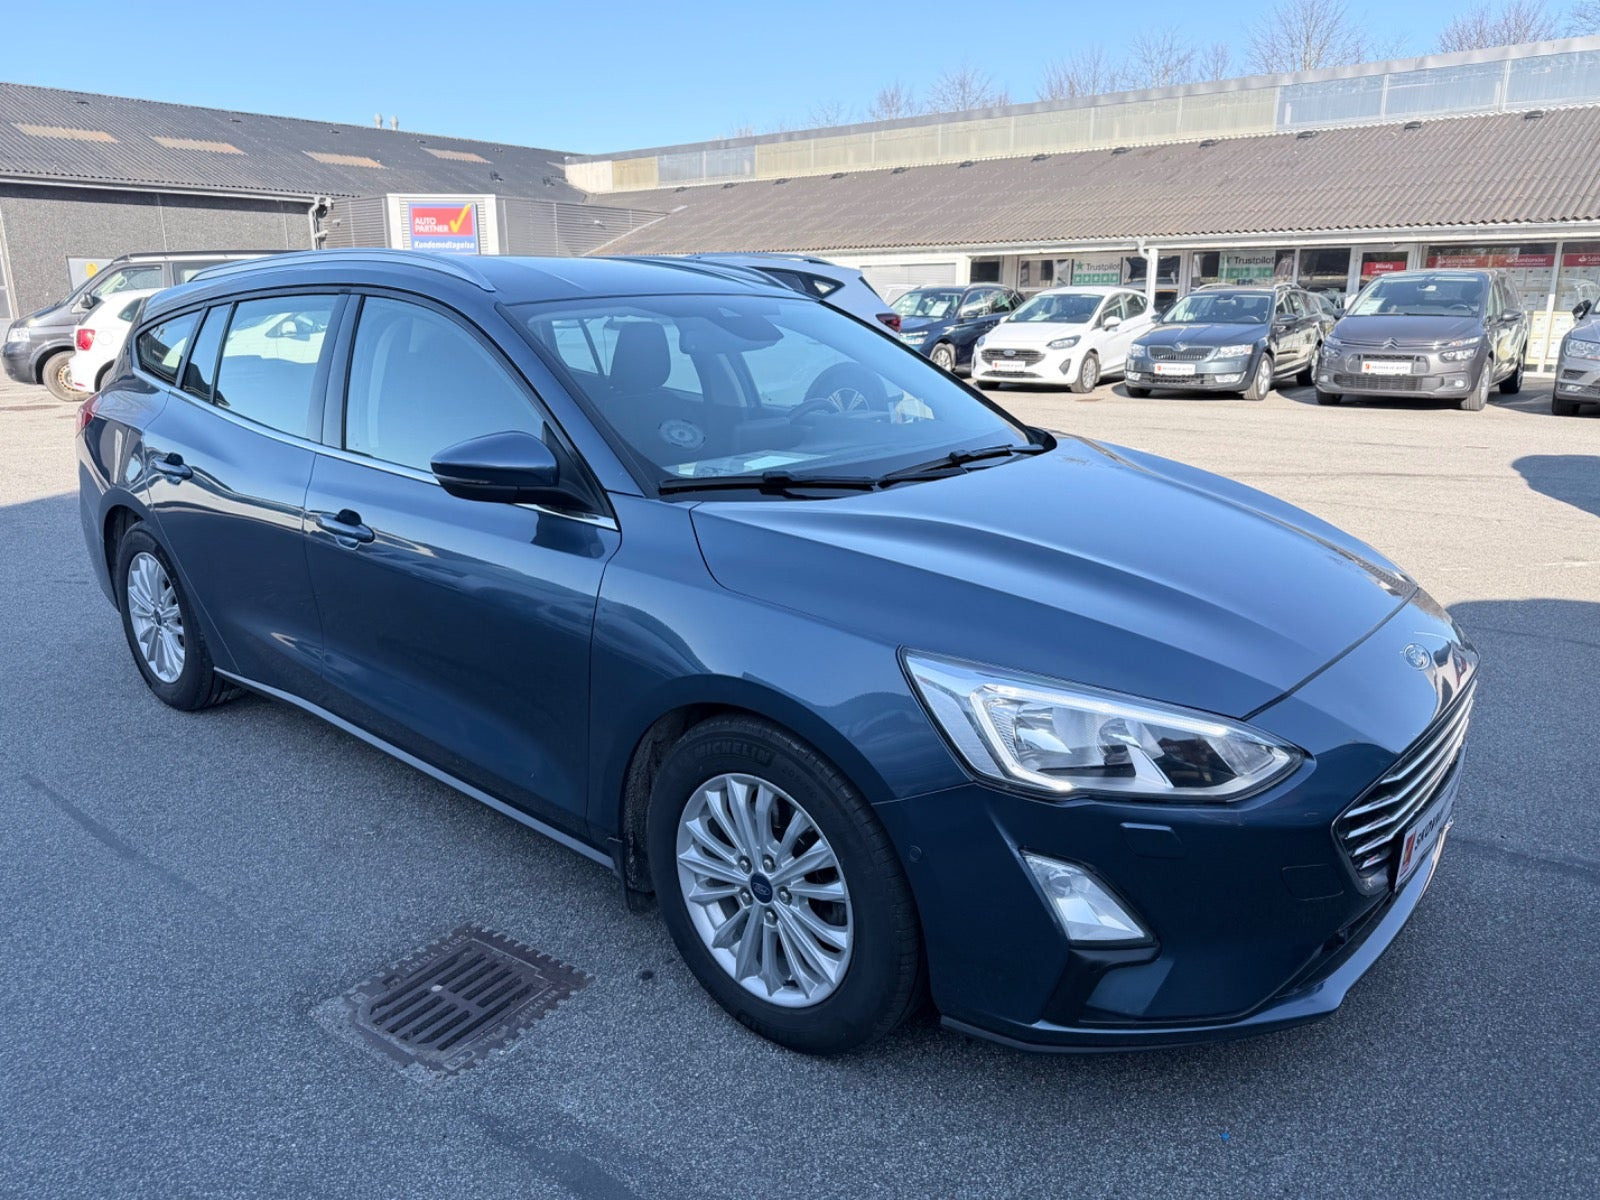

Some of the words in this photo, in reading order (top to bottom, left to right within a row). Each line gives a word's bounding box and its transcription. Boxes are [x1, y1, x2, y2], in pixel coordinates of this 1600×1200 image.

[415, 217, 437, 225] AUTO
[415, 225, 449, 233] PARTNER
[1234, 255, 1274, 265] Trustpilot
[1086, 262, 1121, 272] Trustpilot
